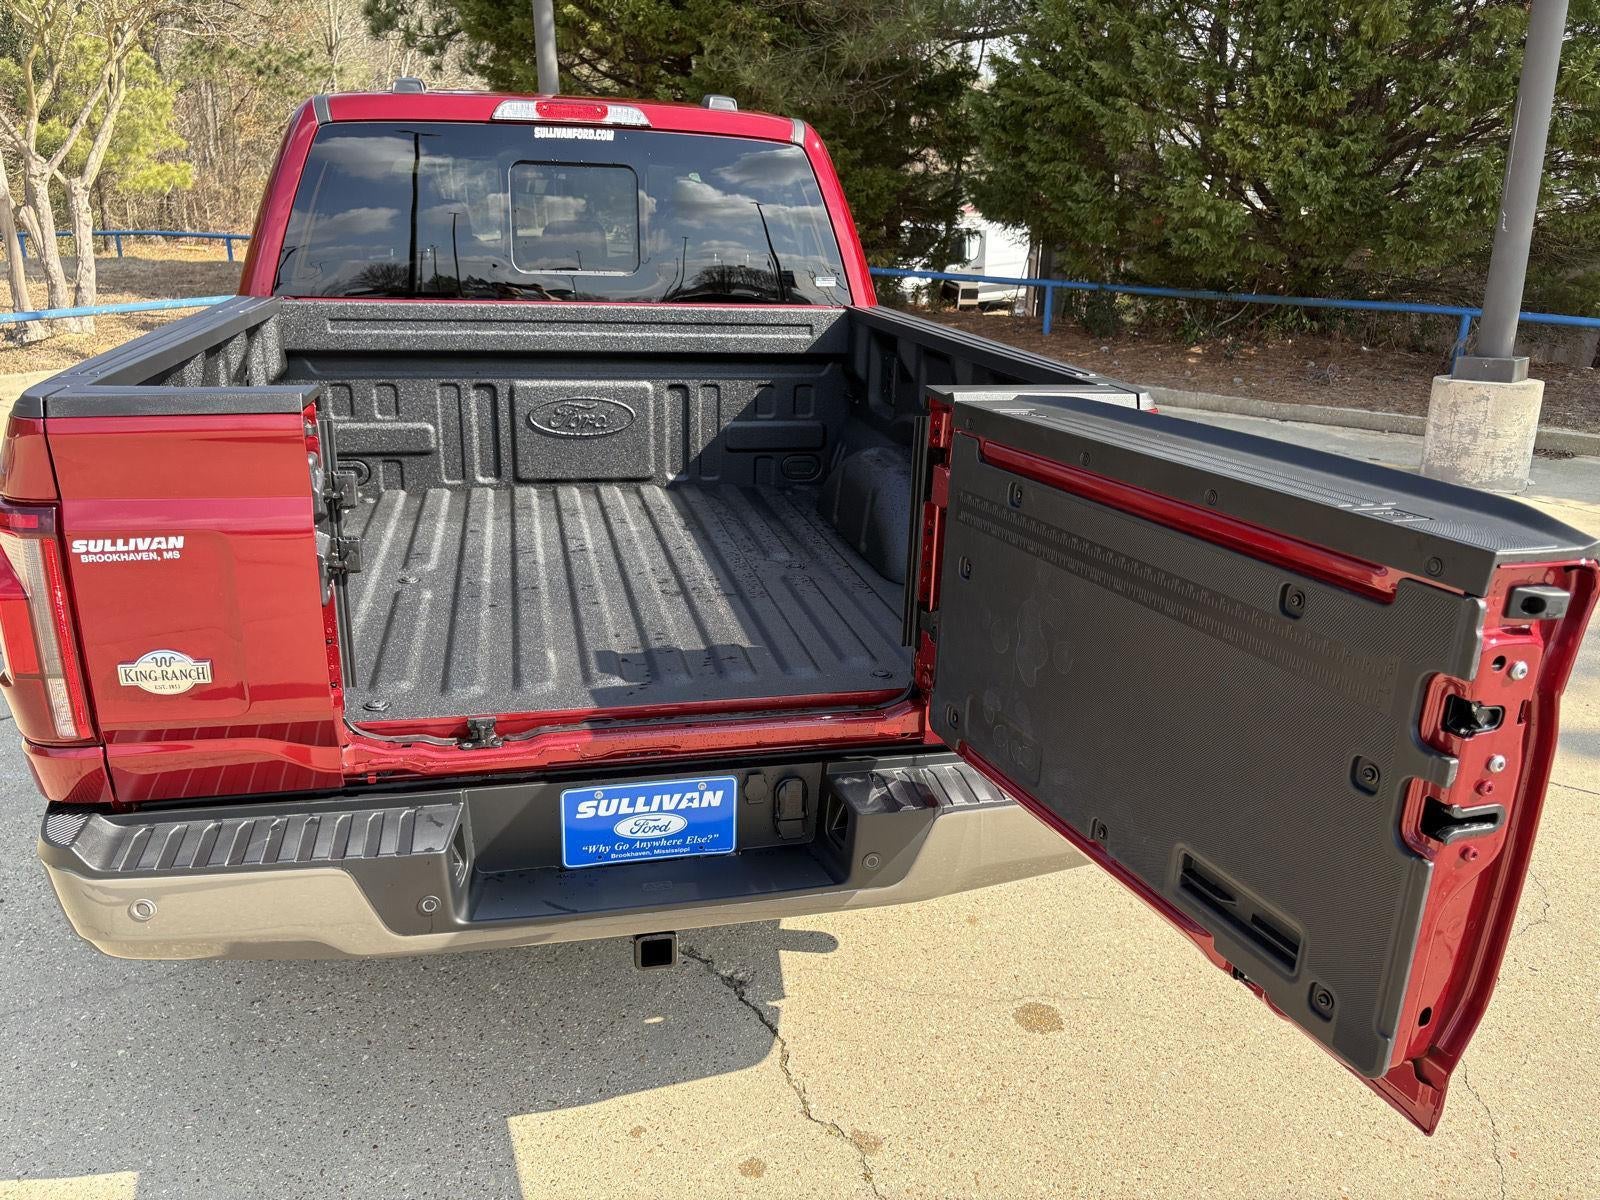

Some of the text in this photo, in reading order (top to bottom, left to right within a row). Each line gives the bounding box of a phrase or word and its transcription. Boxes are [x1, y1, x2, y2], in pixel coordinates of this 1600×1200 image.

[534, 127, 614, 141] SULLIVANFORD.COM
[550, 401, 616, 429] Ford
[72, 536, 184, 553] SULLIVAN
[80, 550, 180, 563] BROOKHAVEN, MS
[575, 790, 724, 819] SULLIVAN
[629, 818, 670, 835] Ford
[614, 840, 630, 851] Go
[633, 837, 683, 849] Anywhere
[610, 847, 691, 859] Brookhaven, Mississippi
